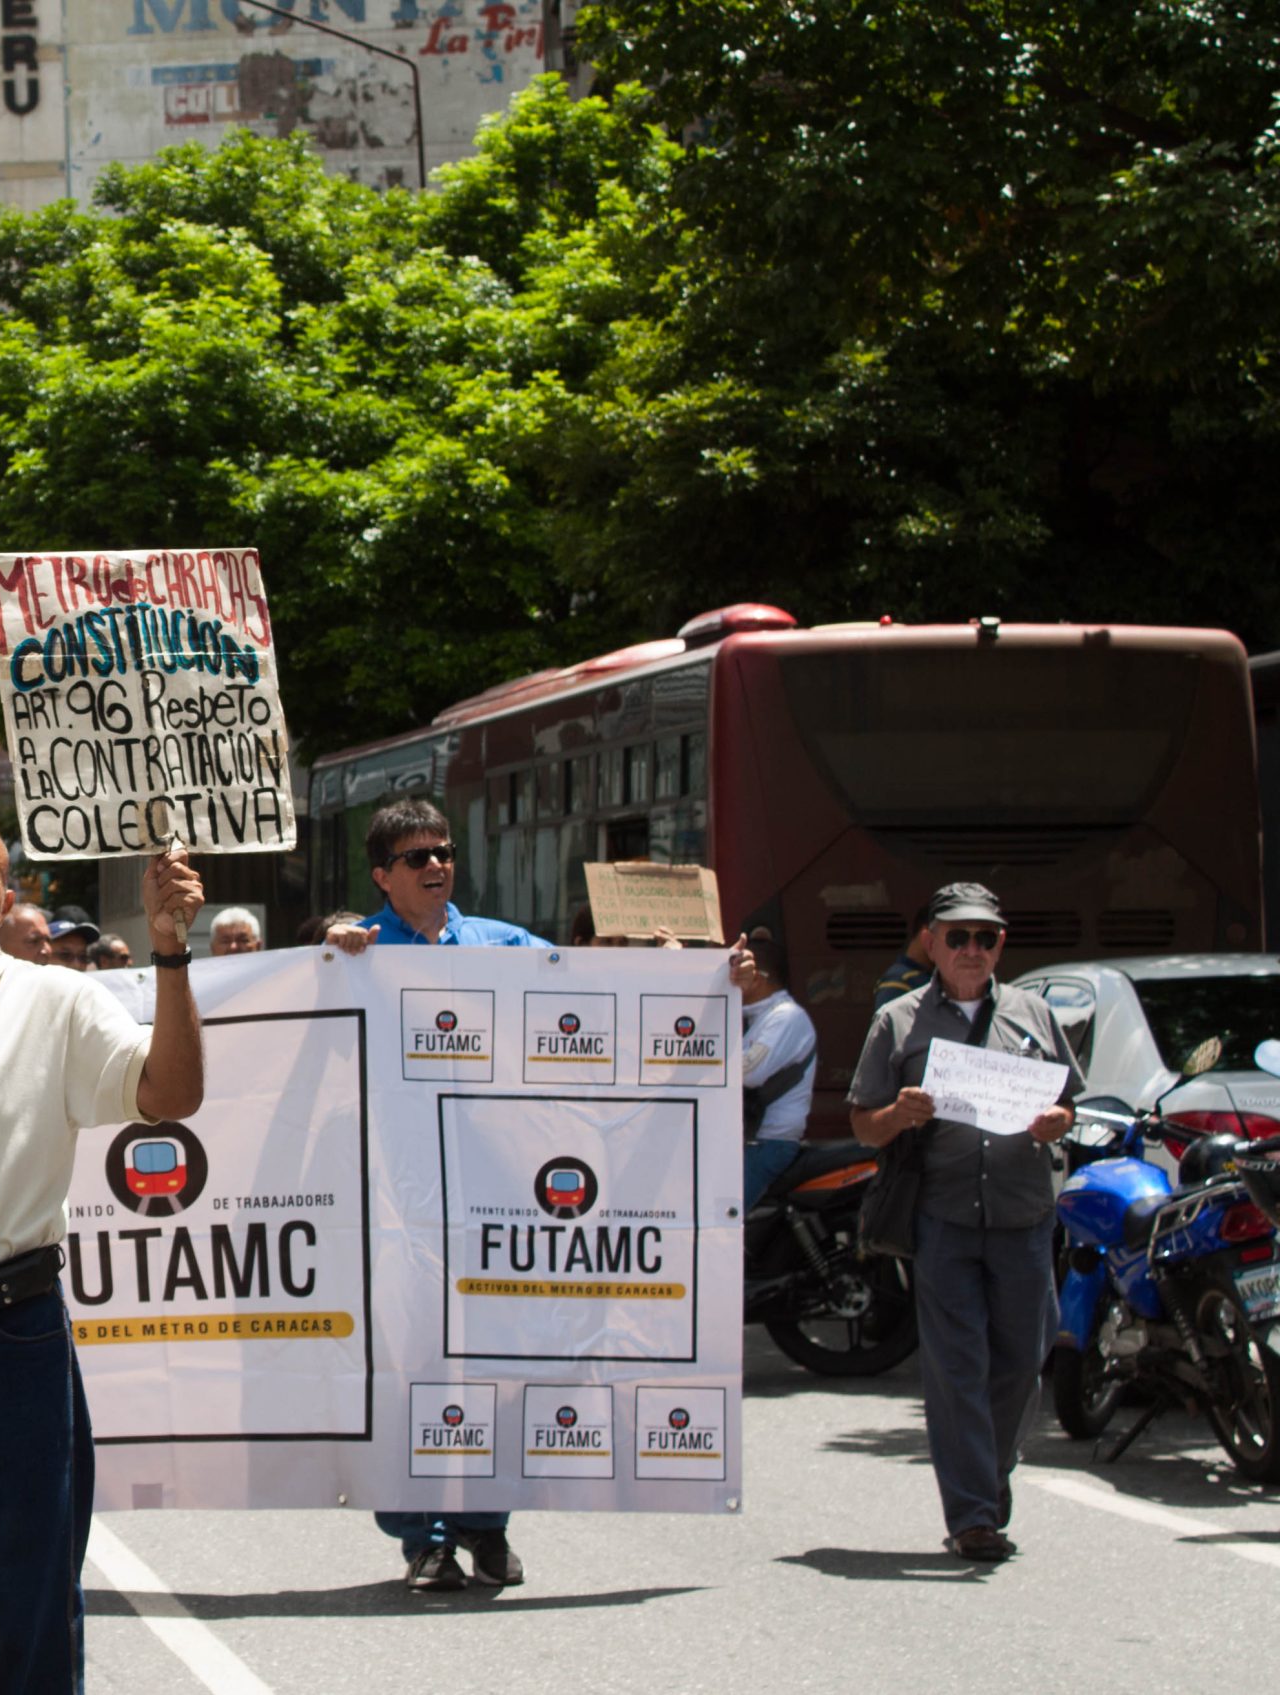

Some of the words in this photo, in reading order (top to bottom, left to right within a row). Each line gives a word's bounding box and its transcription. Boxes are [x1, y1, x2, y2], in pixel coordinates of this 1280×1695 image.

[66, 680, 133, 734] 96
[19, 737, 37, 765] A
[21, 768, 55, 800] LA
[415, 1033, 481, 1052] FUTAMC
[537, 1036, 604, 1055] FUTAMC
[653, 1038, 715, 1057] FUTAMC
[213, 1198, 229, 1210] DE
[237, 1194, 335, 1209] TRABAJADORES
[470, 1206, 505, 1217] FRENTE
[509, 1207, 539, 1218] UNIDO
[600, 1209, 611, 1218] DE
[613, 1209, 676, 1219] TRABAJADORES
[481, 1223, 662, 1274] FUTAMC
[468, 1282, 518, 1293] ACTIVOS
[524, 1283, 545, 1294] DEL
[551, 1284, 592, 1295] METRO
[597, 1285, 610, 1295] DE
[617, 1285, 673, 1296] CARACAS
[98, 1325, 132, 1338] DEL
[142, 1321, 209, 1336] METRO
[219, 1320, 241, 1333] DE
[251, 1319, 333, 1333] CARACAS
[422, 1428, 484, 1447] FUTAMC
[535, 1429, 602, 1448] FUTAMC
[648, 1431, 713, 1450] FUTAMC
